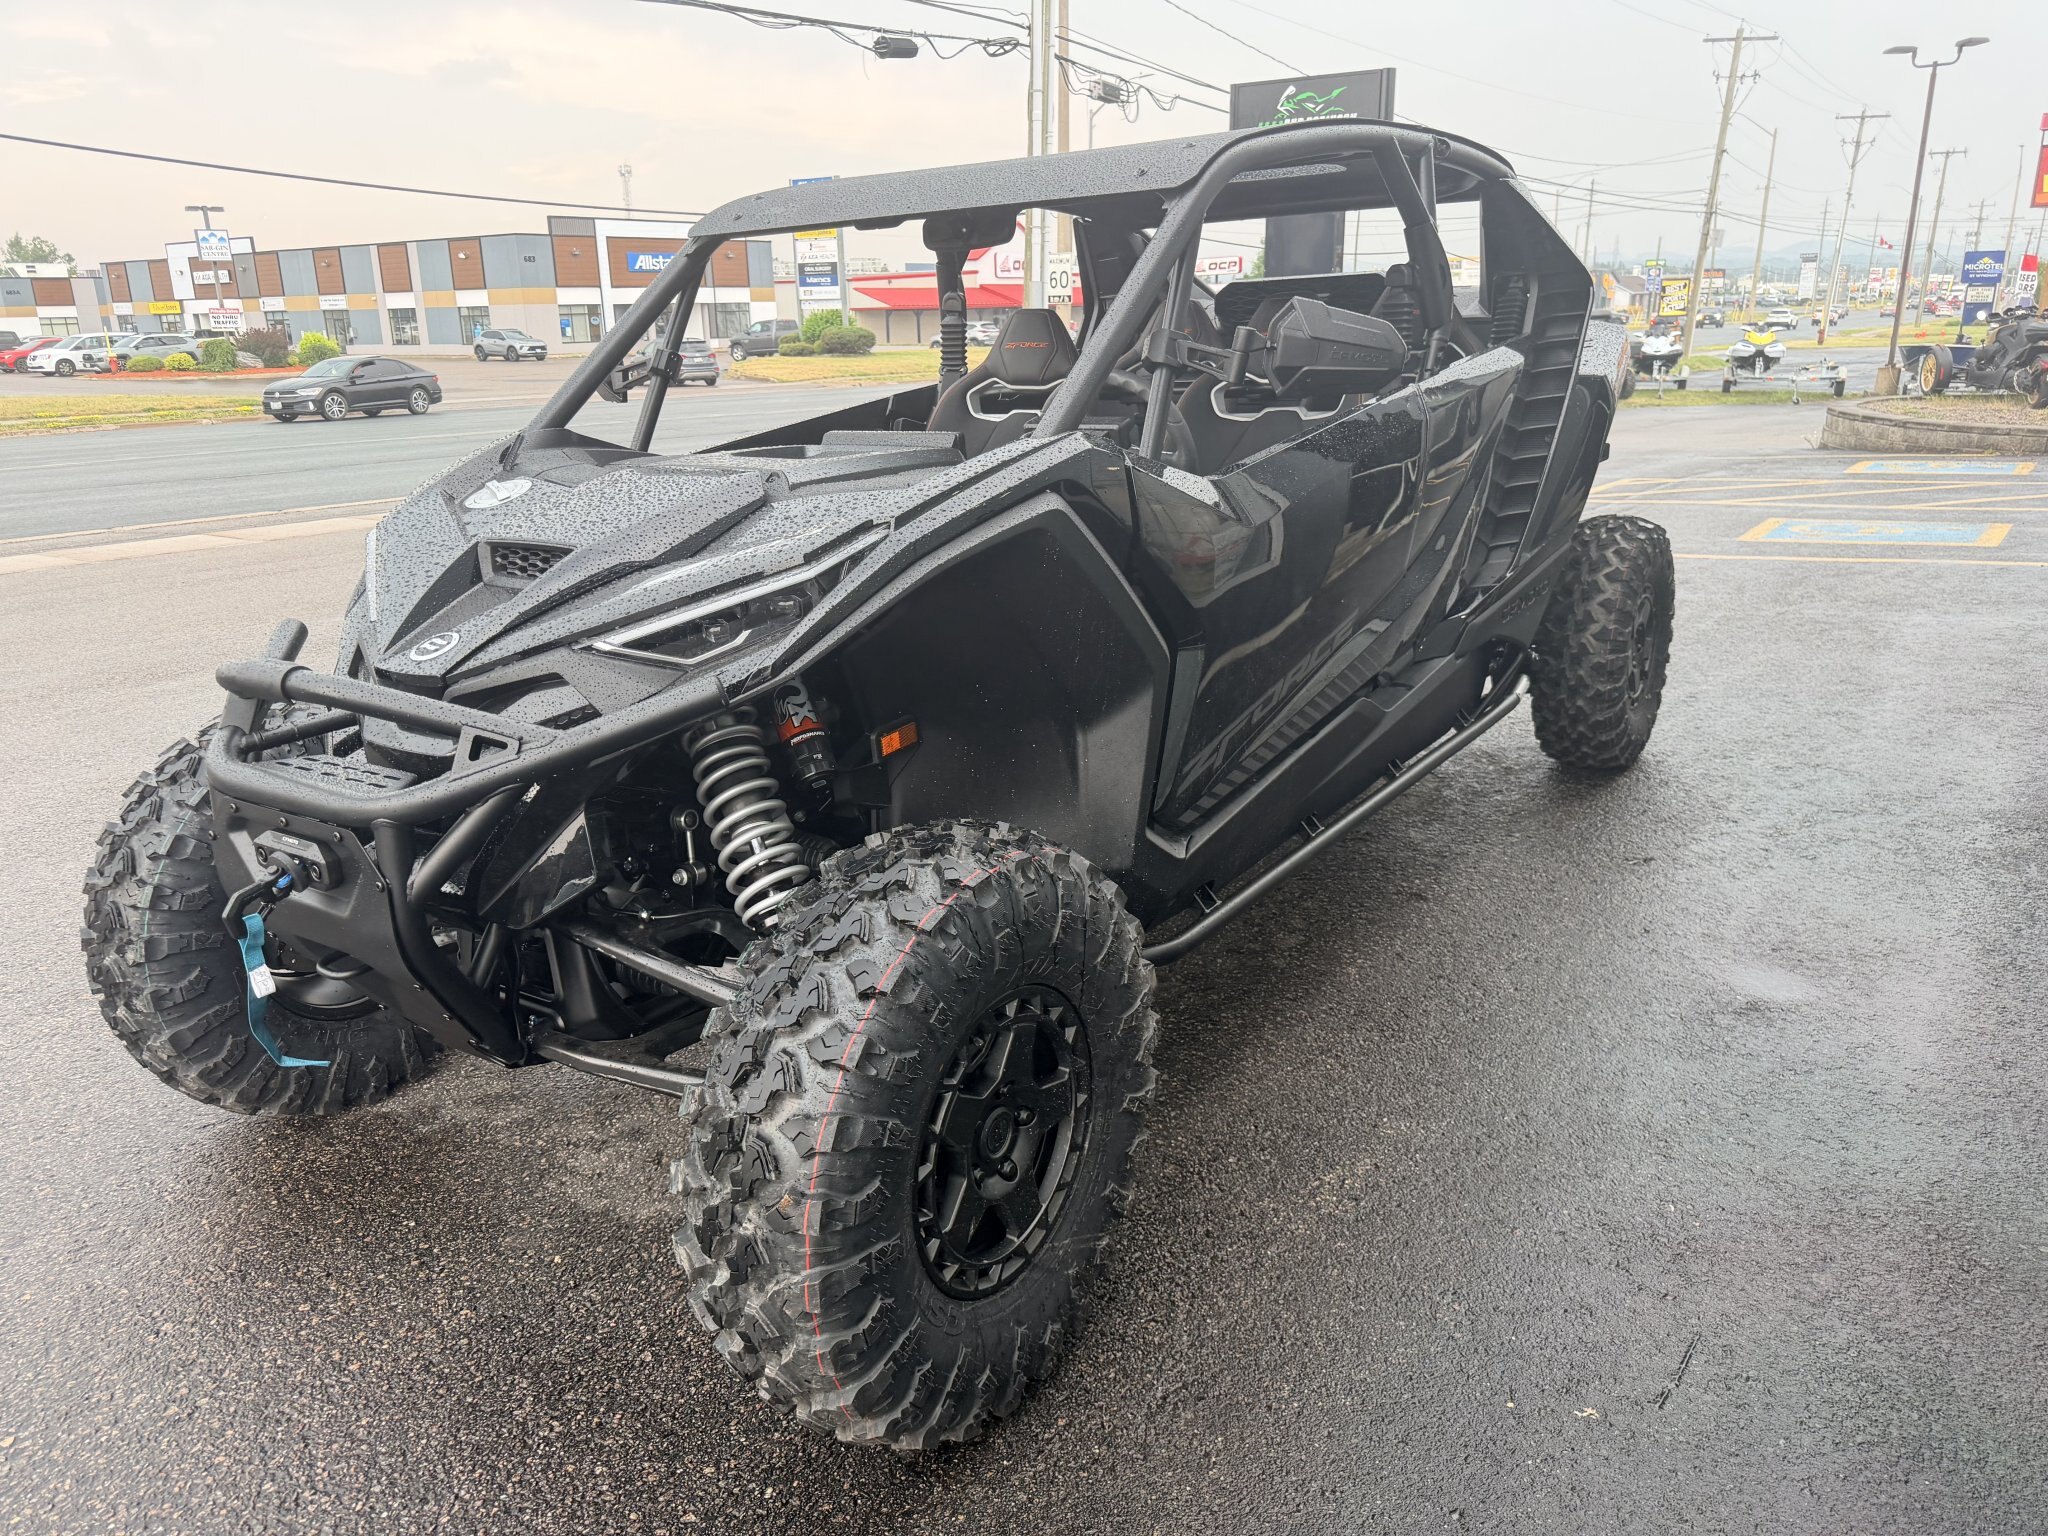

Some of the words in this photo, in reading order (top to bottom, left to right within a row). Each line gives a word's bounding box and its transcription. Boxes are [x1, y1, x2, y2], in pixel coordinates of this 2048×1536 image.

[634, 254, 674, 270] Allsta
[1208, 261, 1238, 271] OCP
[1964, 263, 2004, 271] MICROTEL
[1049, 270, 1069, 289] 60
[1665, 282, 1686, 294] BEST
